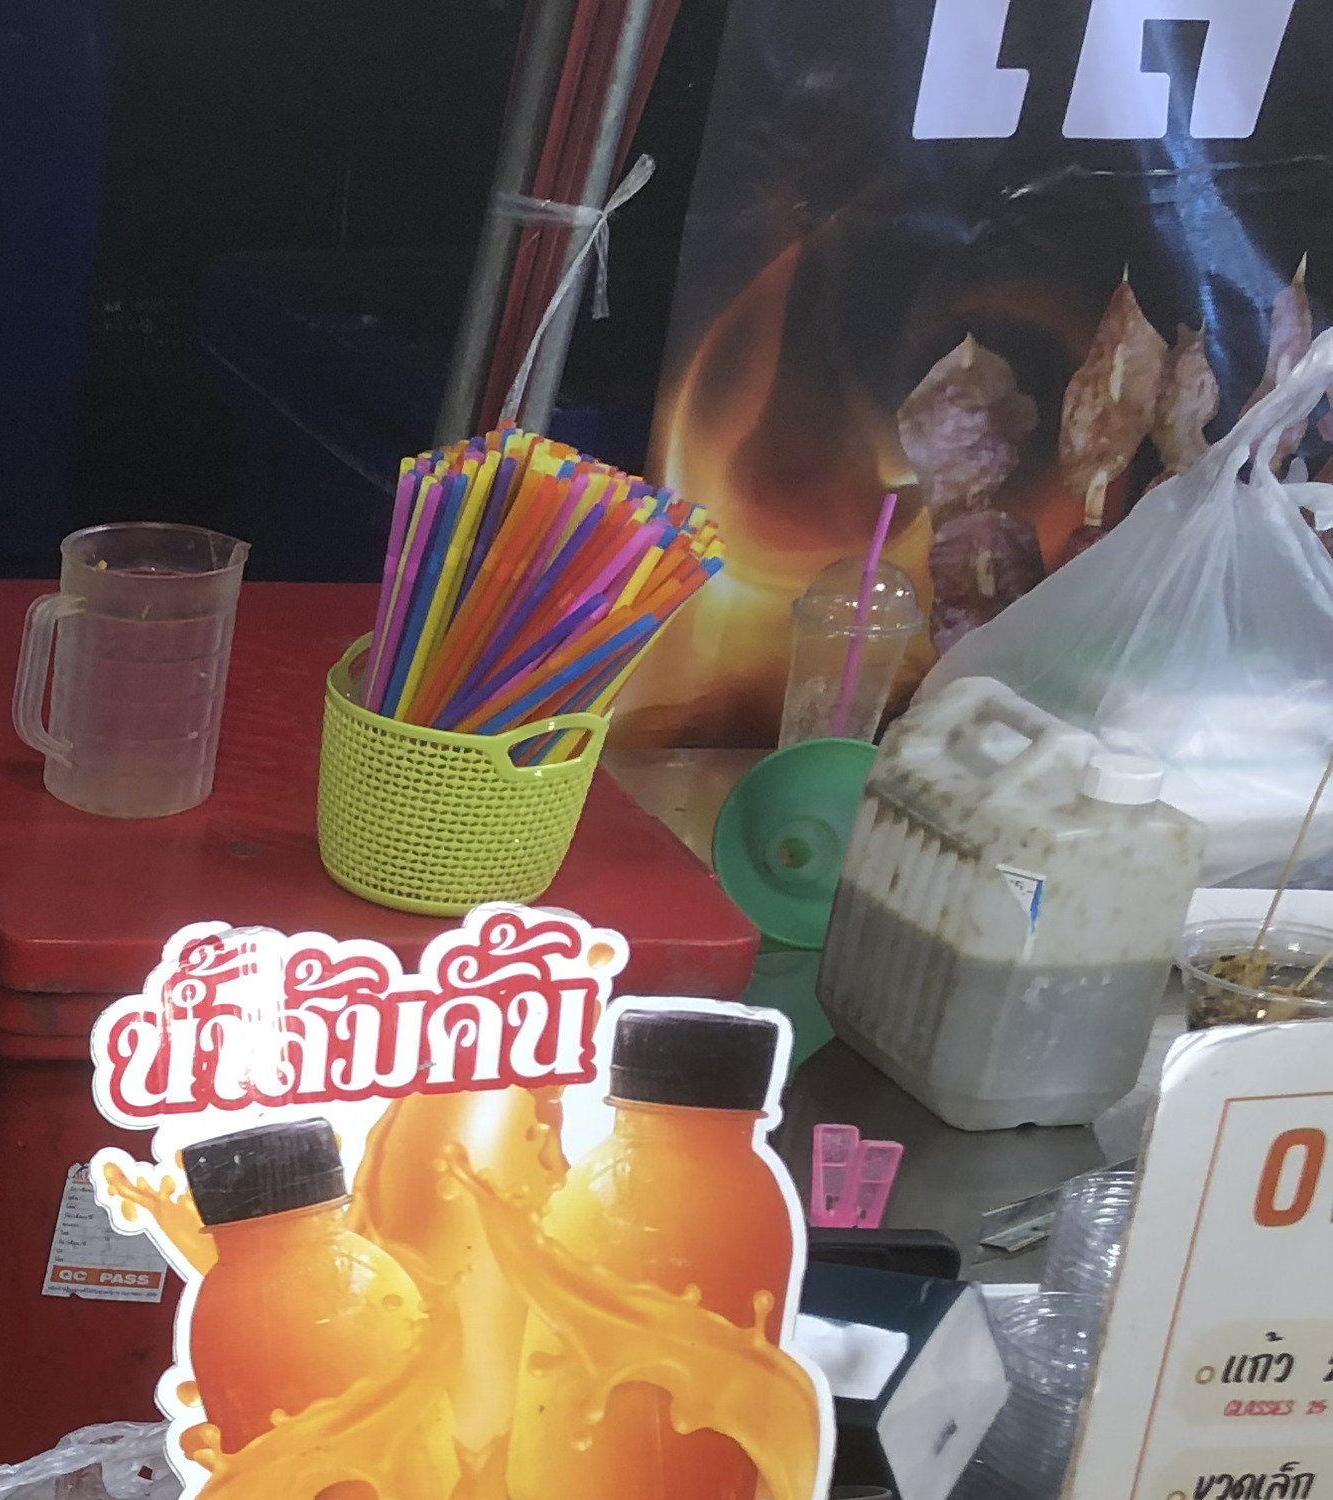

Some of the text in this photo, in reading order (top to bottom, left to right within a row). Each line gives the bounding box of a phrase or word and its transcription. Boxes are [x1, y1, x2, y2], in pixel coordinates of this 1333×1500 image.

[111, 908, 595, 1110] น้ำส้มคั้น
[1253, 1126, 1333, 1228] O
[58, 1269, 150, 1286] QC PASS
[1220, 1331, 1295, 1384] แก้ว
